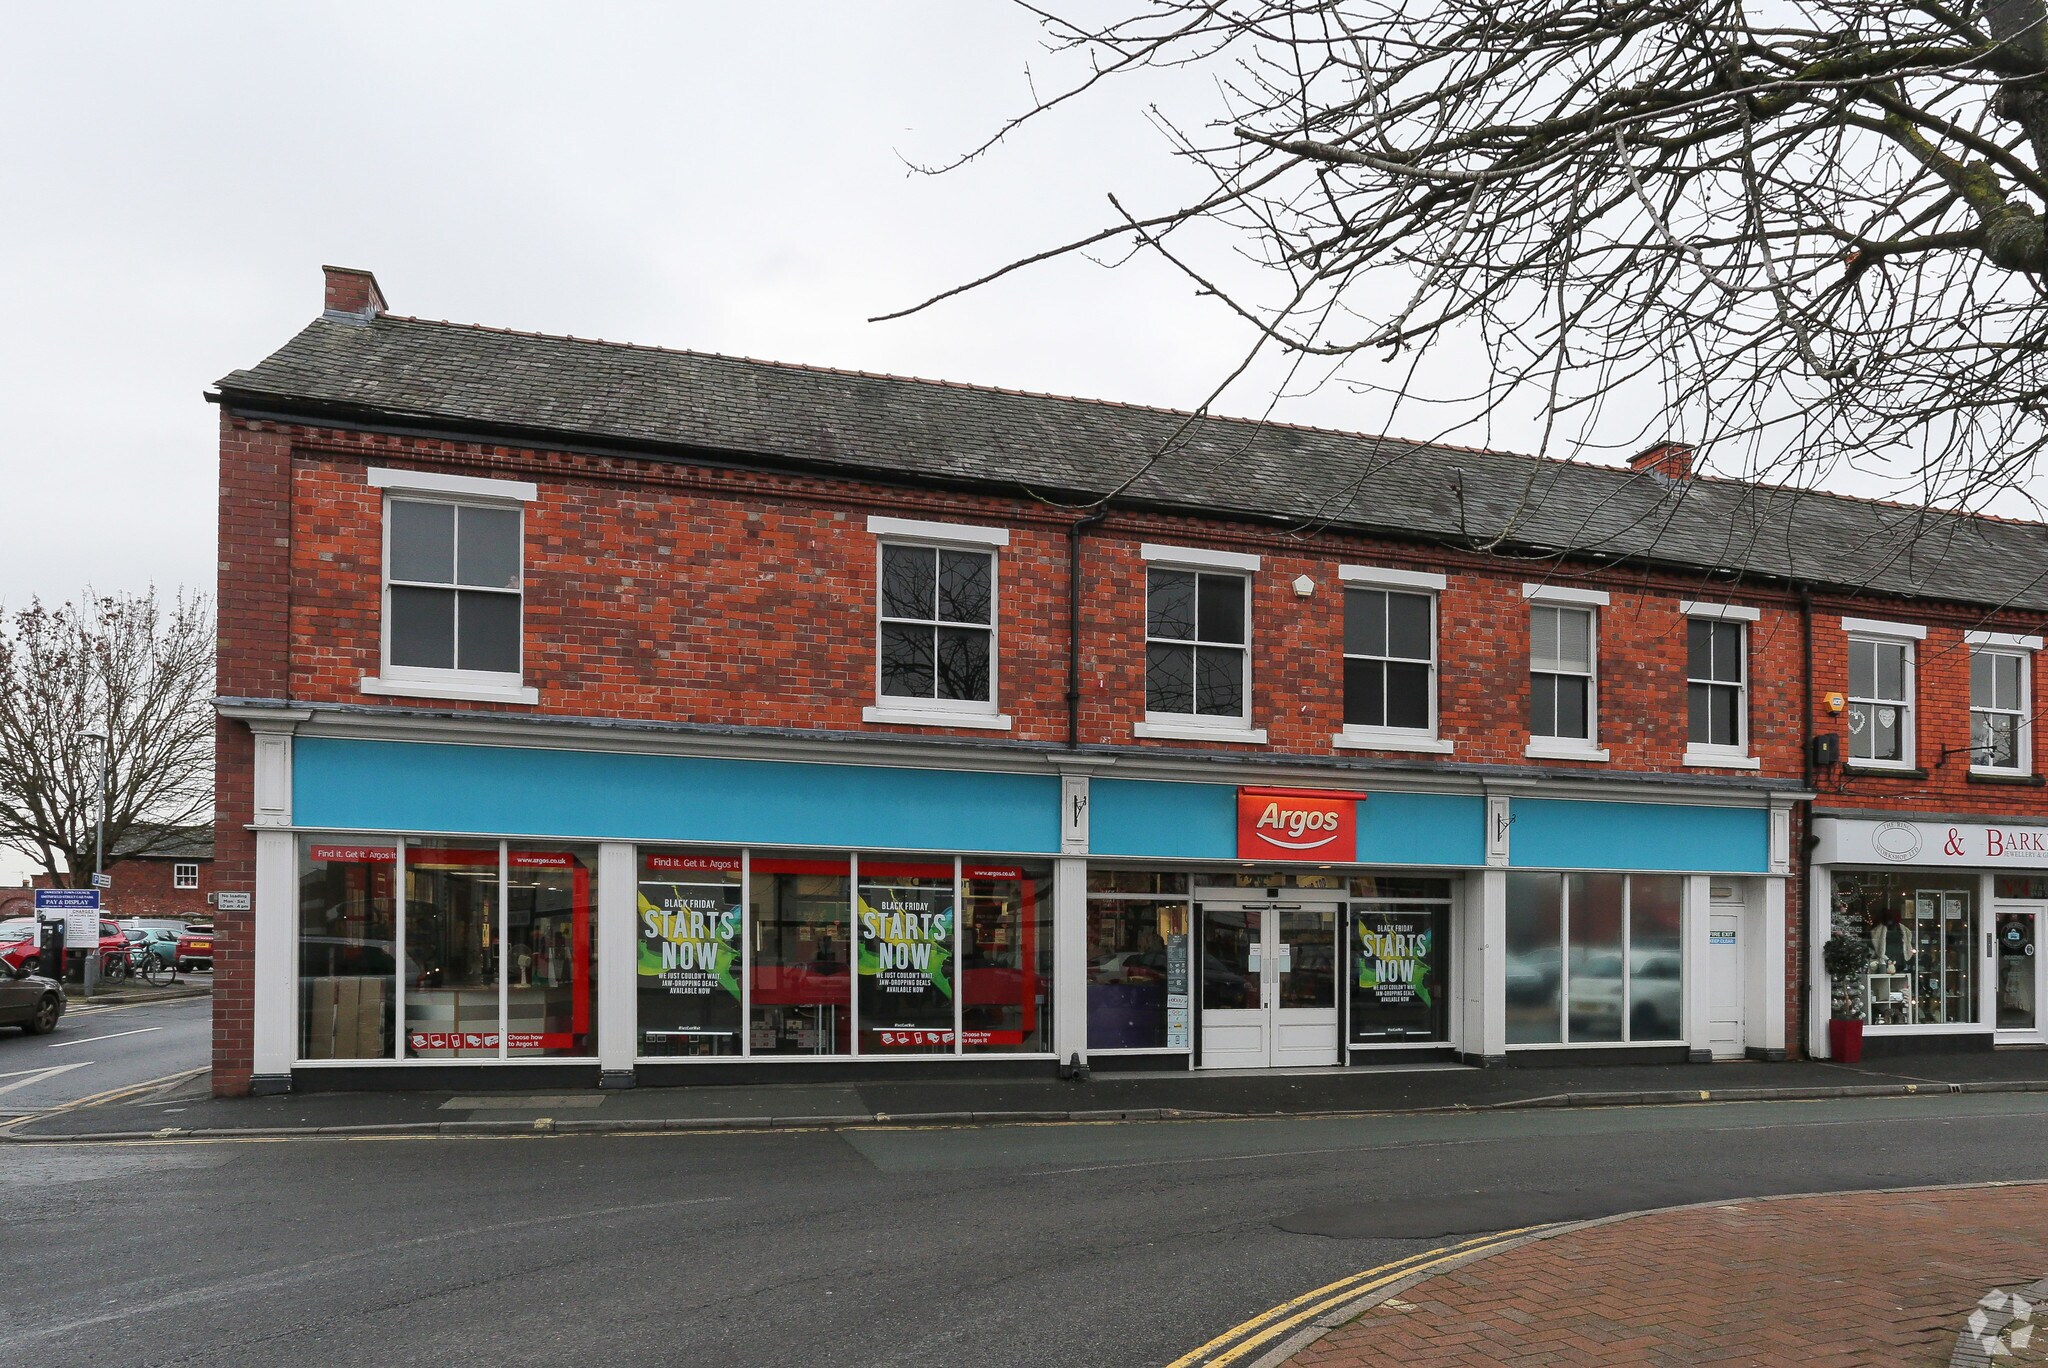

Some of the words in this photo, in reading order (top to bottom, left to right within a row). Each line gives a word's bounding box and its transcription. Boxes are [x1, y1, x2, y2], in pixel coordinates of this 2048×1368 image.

[1256, 802, 1339, 837] Argos
[1882, 821, 1894, 829] THE
[1896, 821, 1912, 830] RING
[1943, 827, 1966, 857] &
[1985, 828, 2048, 857] BARK
[317, 850, 334, 858] Find
[369, 851, 390, 861] Argos
[1876, 844, 1907, 860] WORKSHOP
[1908, 846, 1919, 857] LTD
[517, 857, 566, 865] www.argos.co.uk
[653, 858, 671, 867] Find
[673, 858, 681, 867] it.
[683, 859, 697, 868] Get
[699, 859, 707, 868] it.
[709, 860, 731, 870] Argos
[733, 860, 740, 869] it
[664, 898, 688, 908] BLACK
[689, 899, 715, 909] FRIDAY
[881, 901, 904, 910] BLACK
[904, 901, 929, 911] FRIDAY
[644, 909, 734, 940] STARTS
[863, 912, 946, 940] STARTS
[1377, 924, 1394, 932] BLACK
[1395, 924, 1414, 932] FRIDAY
[1363, 934, 1427, 957] STARTS
[662, 941, 719, 970] NOW
[879, 942, 931, 970] NOW
[680, 972, 706, 980] COULDN'T
[1375, 959, 1415, 983] NOW
[669, 987, 697, 995] AVAILABLE
[698, 987, 711, 995] NOW
[968, 1037, 983, 1045] Argos
